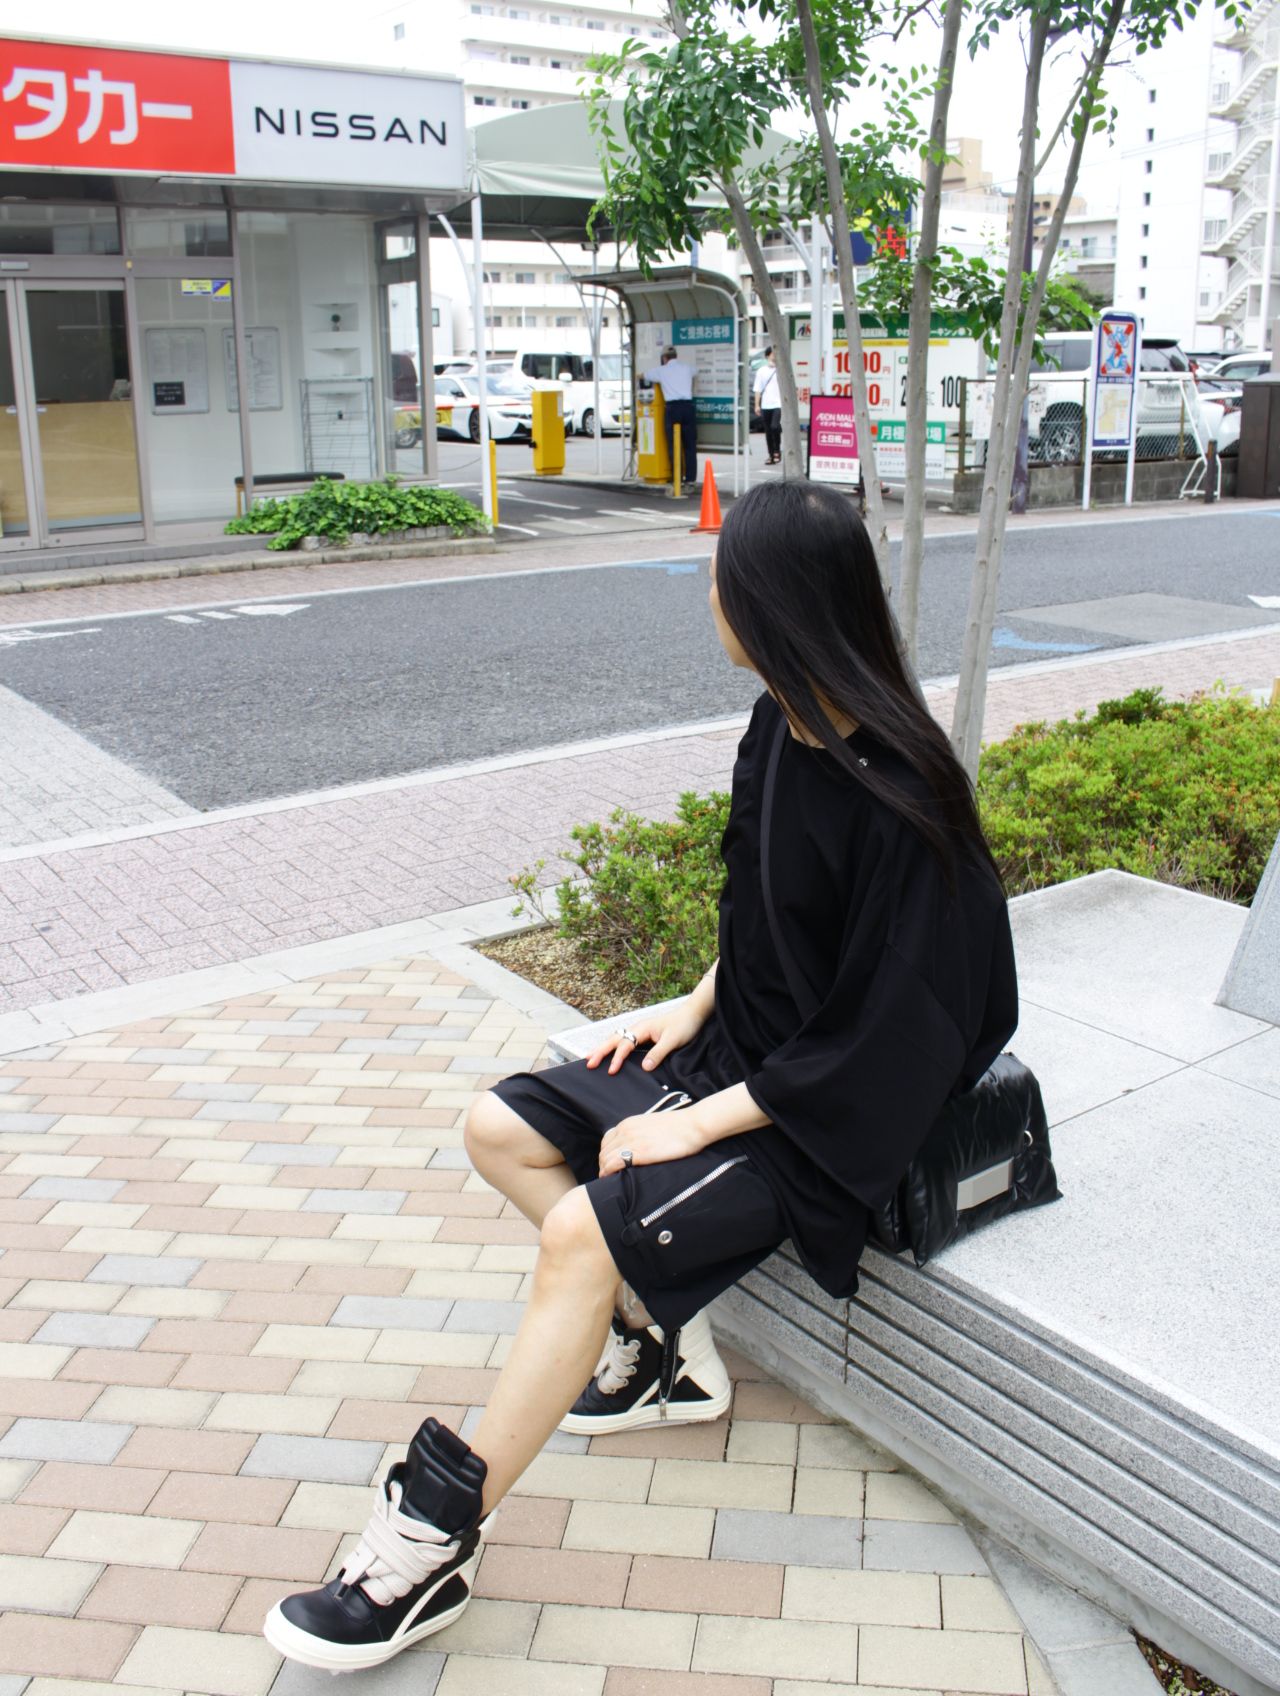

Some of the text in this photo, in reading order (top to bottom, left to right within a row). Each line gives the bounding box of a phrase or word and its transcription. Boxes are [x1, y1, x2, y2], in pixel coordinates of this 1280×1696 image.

[3, 66, 192, 144] タカー
[255, 106, 447, 145] NISSAN
